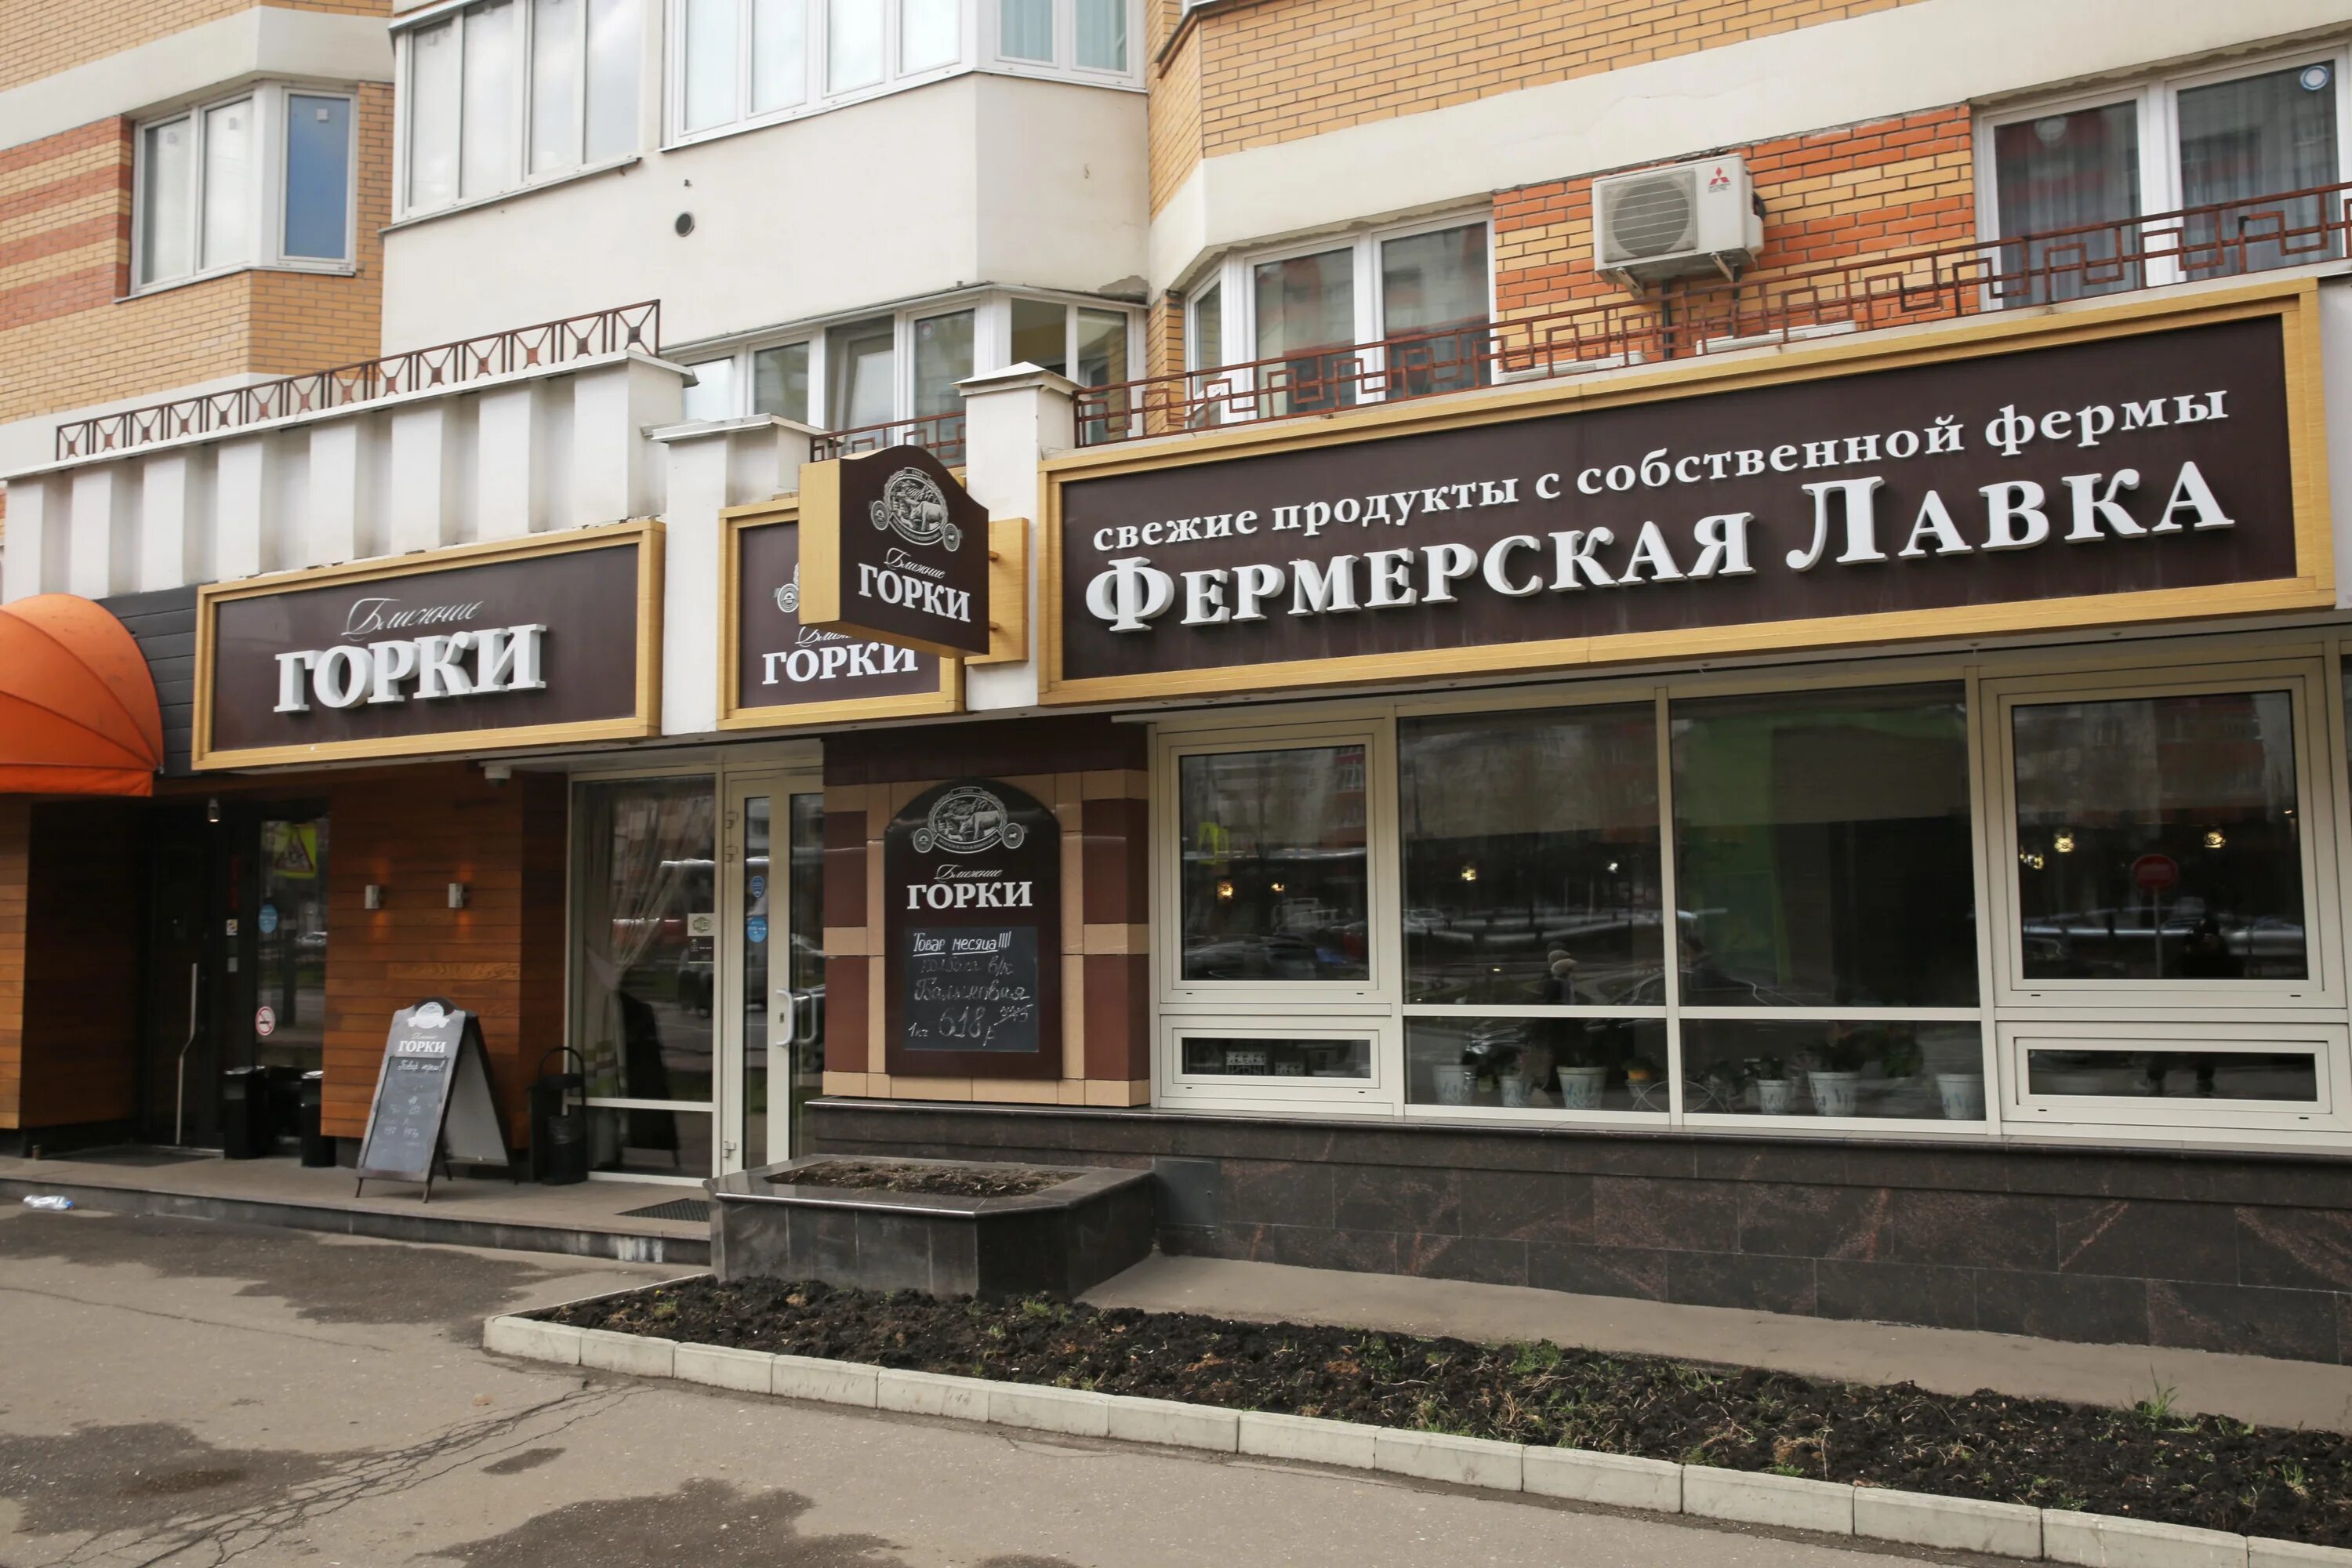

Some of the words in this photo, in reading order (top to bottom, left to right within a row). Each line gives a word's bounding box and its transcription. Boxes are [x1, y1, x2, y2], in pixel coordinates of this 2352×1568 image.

[1093, 510, 1258, 551] свежие
[1271, 477, 1519, 537] продукты
[1535, 473, 1561, 500] с
[1577, 414, 1965, 495] собственной
[1985, 390, 2229, 456] фермы
[884, 547, 946, 579] Ближние
[858, 562, 971, 622] ГОРКИ
[341, 597, 483, 641] Ближние
[274, 623, 547, 713] ГОРКИ
[762, 641, 918, 685] ГОРКИ
[935, 864, 1003, 883] Ближние
[906, 881, 1033, 909] ГОРКИ
[913, 932, 946, 952] Товар
[398, 1040, 447, 1053] ГОРКИ
